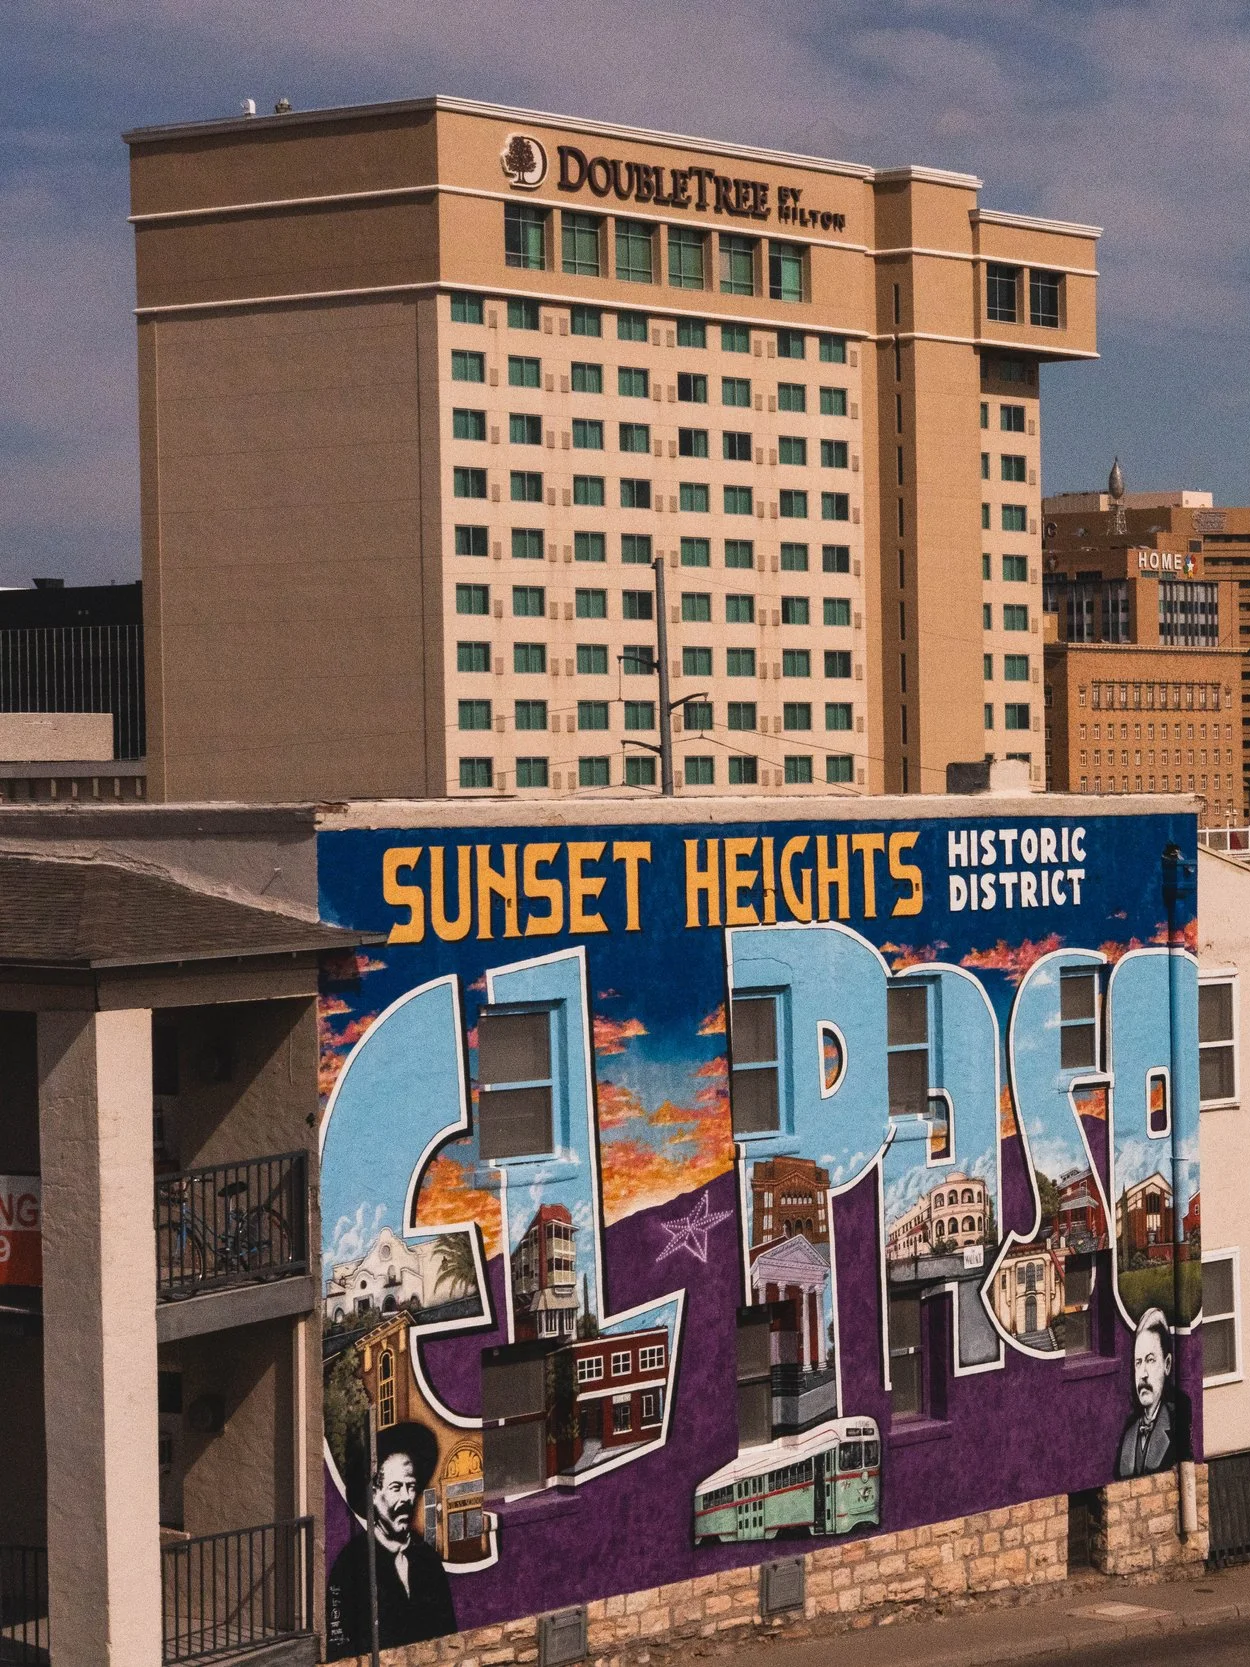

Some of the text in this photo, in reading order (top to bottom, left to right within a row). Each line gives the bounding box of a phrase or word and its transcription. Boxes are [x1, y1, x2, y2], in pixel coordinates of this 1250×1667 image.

[778, 205, 846, 233] HILTON
[1138, 551, 1183, 571] HOME
[947, 826, 1088, 868] HISTORIC
[382, 831, 926, 945] SUNSET HEIGHTS
[948, 868, 1087, 913] DISTRICT
